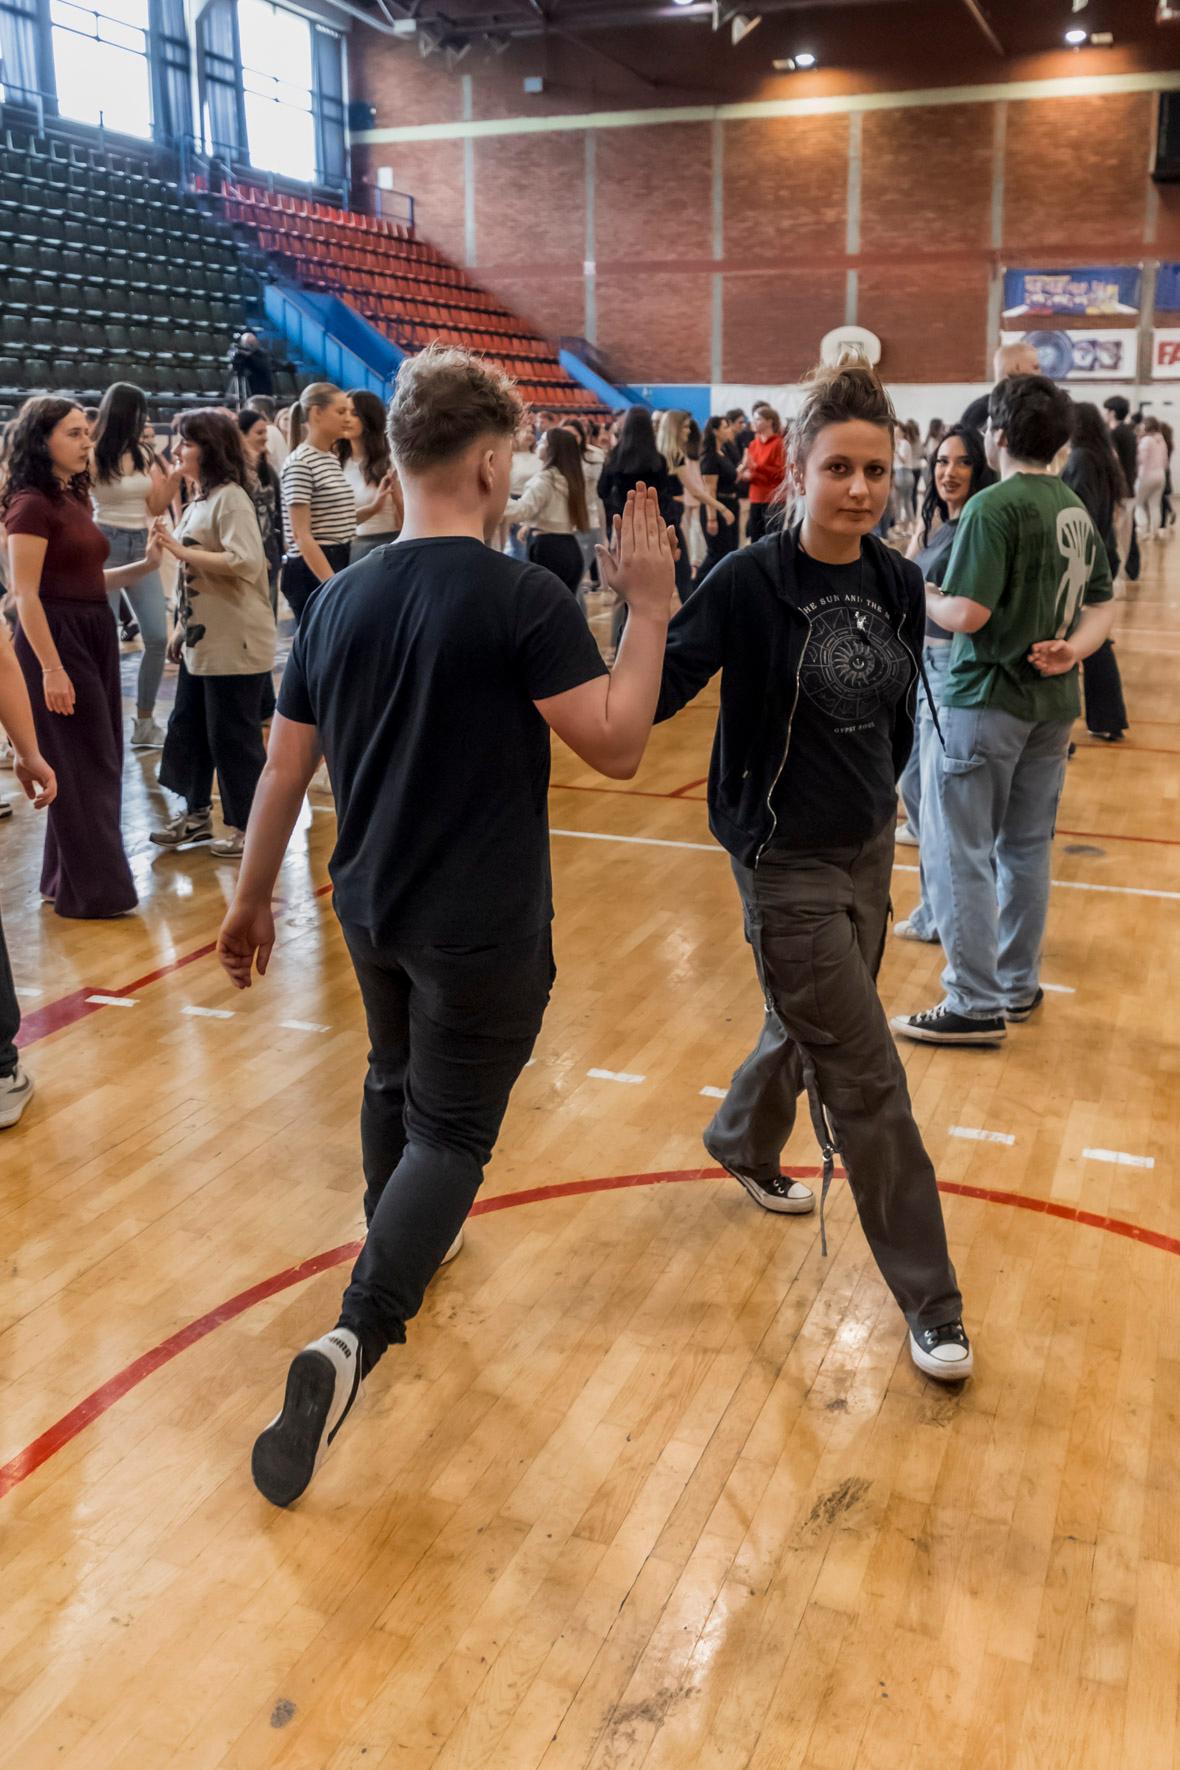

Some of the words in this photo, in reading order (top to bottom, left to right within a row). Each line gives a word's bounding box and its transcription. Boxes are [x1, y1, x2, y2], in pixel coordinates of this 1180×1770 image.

[802, 601, 818, 614] HE
[820, 594, 840, 606] SUN
[866, 599, 883, 613] THE
